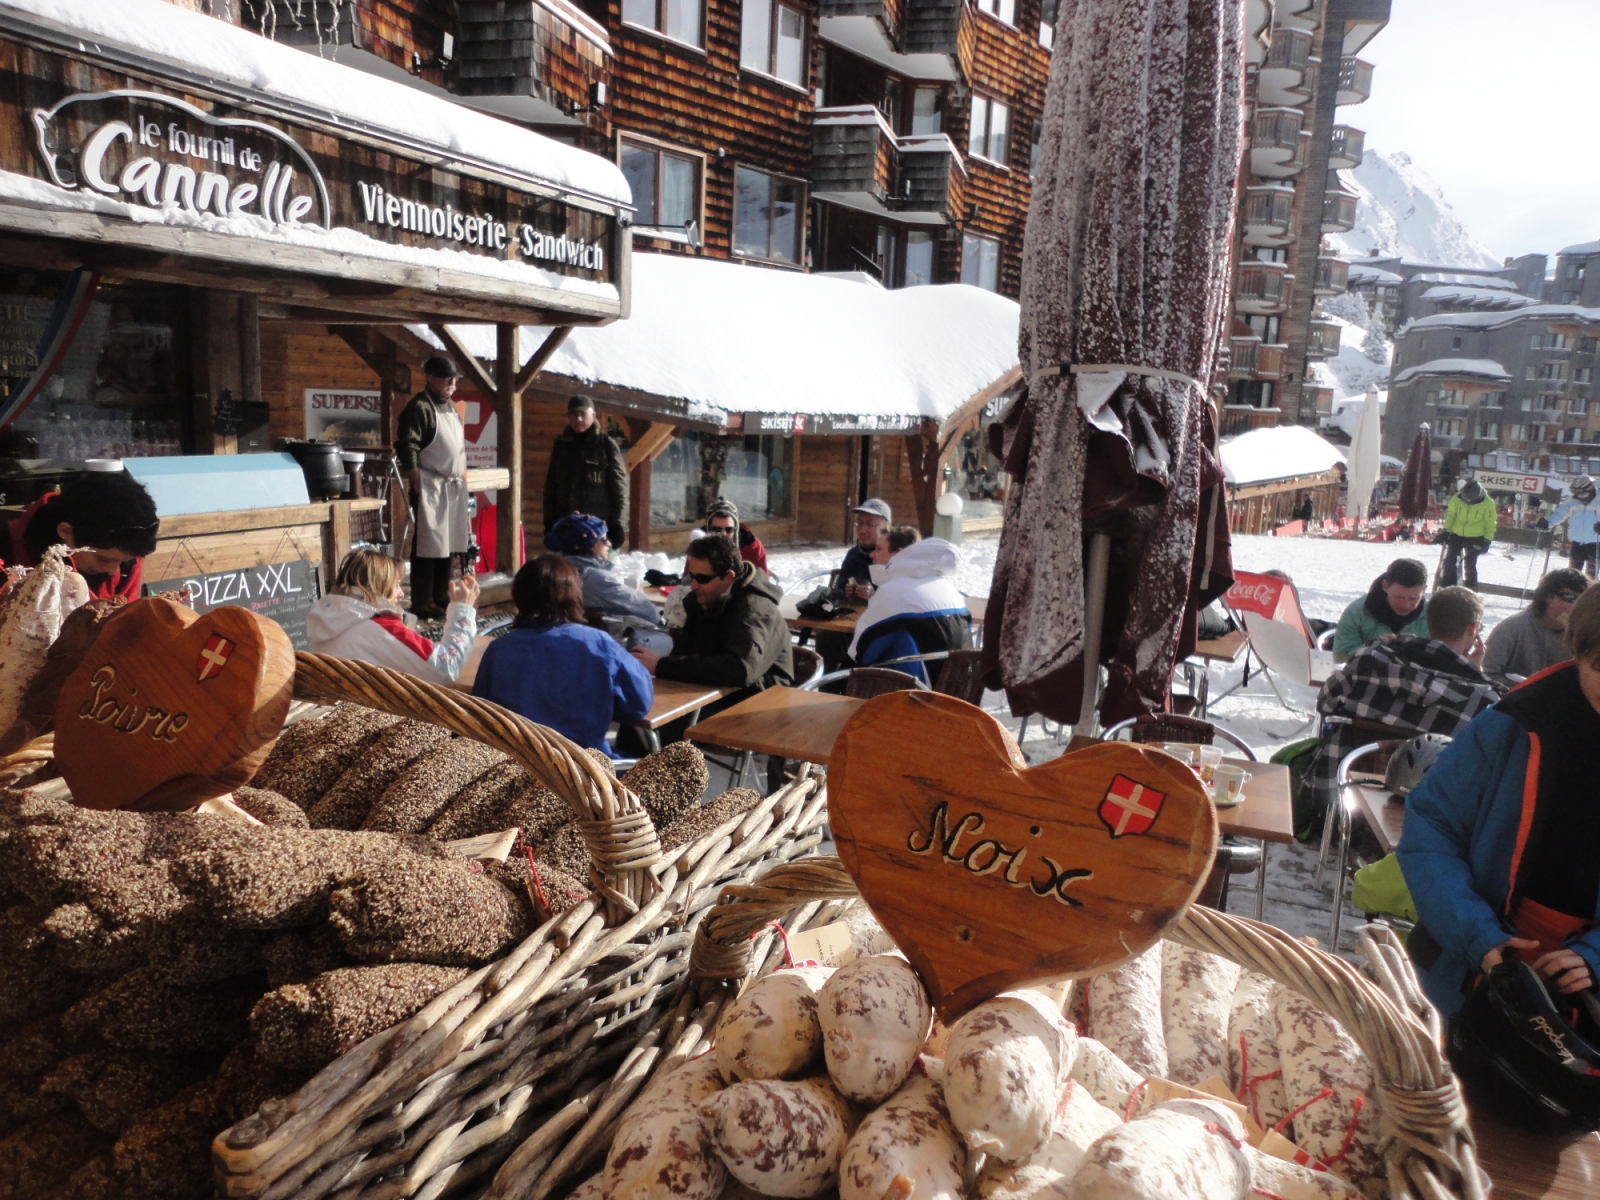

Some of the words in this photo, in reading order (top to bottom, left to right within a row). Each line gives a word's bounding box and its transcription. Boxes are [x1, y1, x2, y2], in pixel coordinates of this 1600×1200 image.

[81, 120, 313, 227] Cannelle
[139, 114, 161, 148] le
[168, 122, 235, 166] fournil
[239, 147, 262, 172] de
[358, 180, 507, 250] Viennoiserie
[520, 223, 603, 271] Sandwich
[1480, 475, 1522, 486] SKISET
[78, 663, 189, 743] Poivre
[907, 800, 1094, 907] Noix
